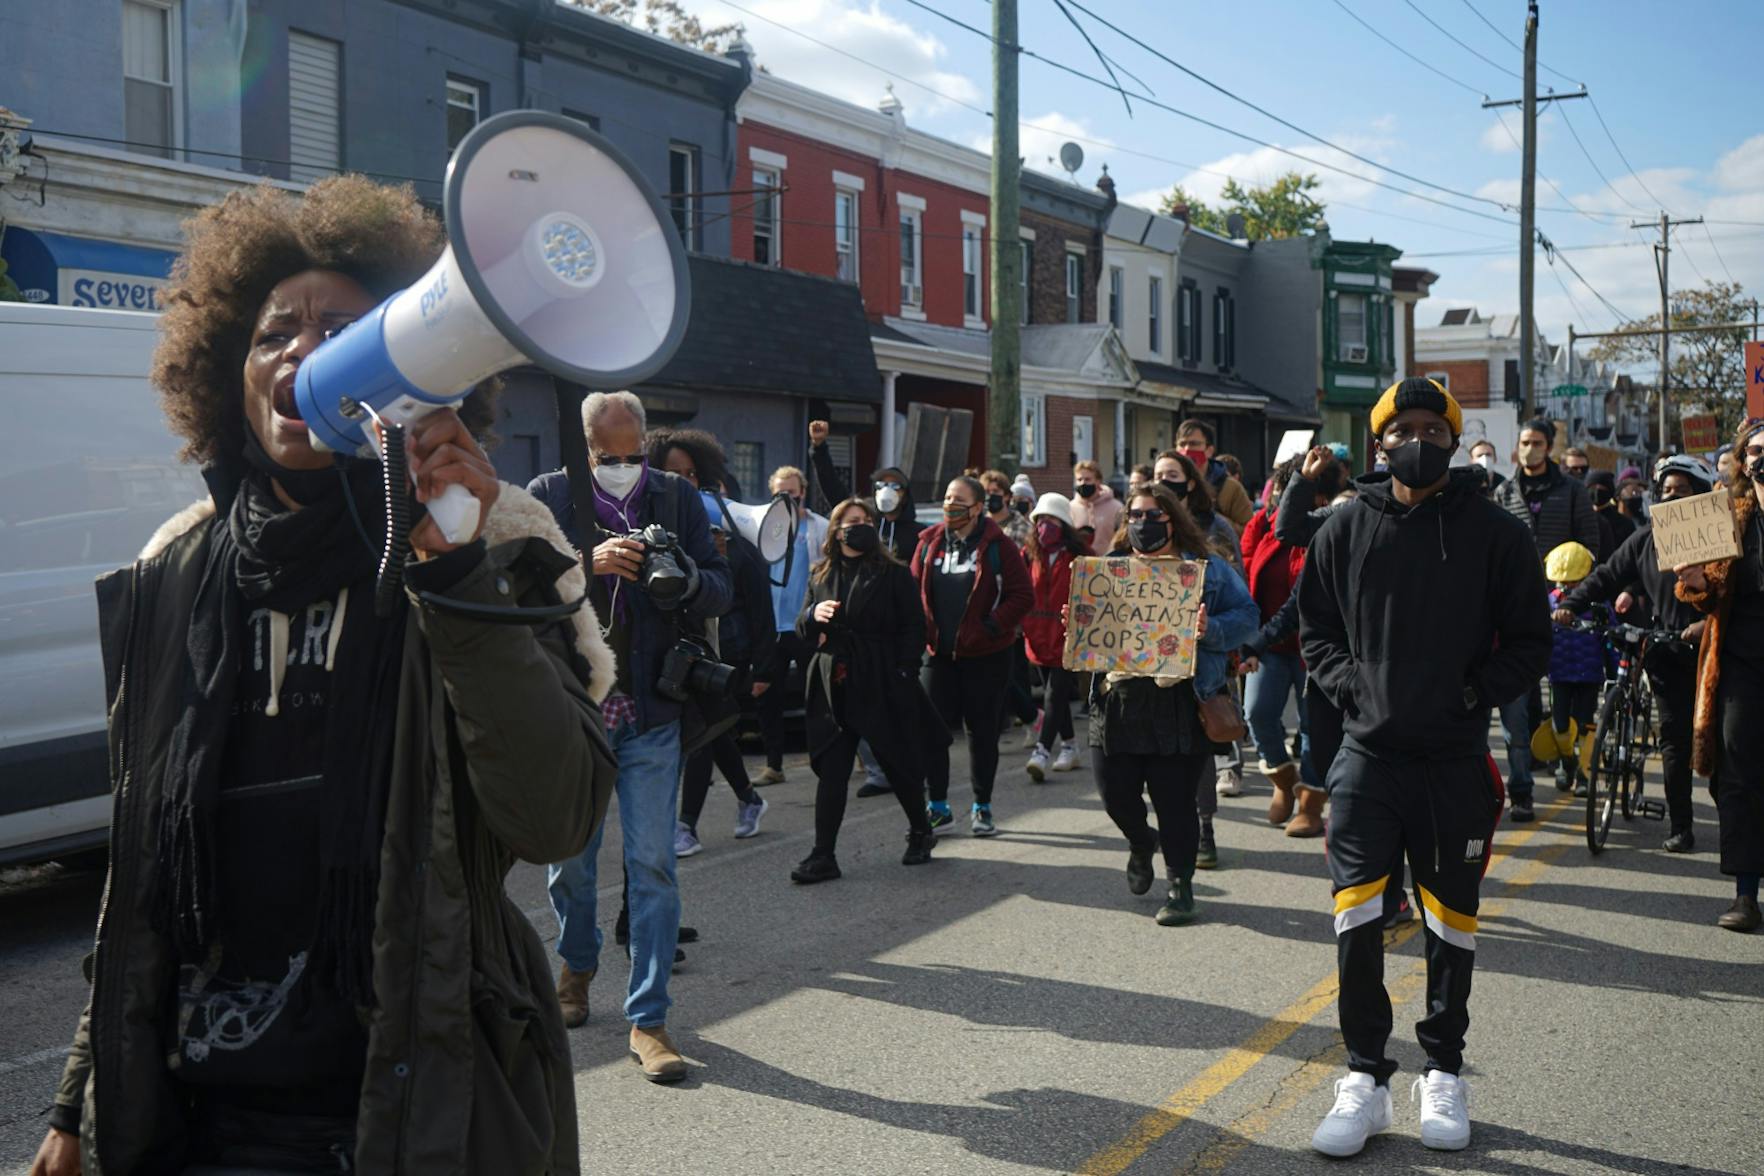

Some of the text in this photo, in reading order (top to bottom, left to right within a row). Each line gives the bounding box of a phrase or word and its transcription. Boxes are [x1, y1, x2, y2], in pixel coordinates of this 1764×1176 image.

[1651, 495, 1726, 529] WALTER
[1657, 520, 1728, 556] WALLACE
[1096, 602, 1199, 627] AGAINST
[1087, 628, 1147, 651] COPS
